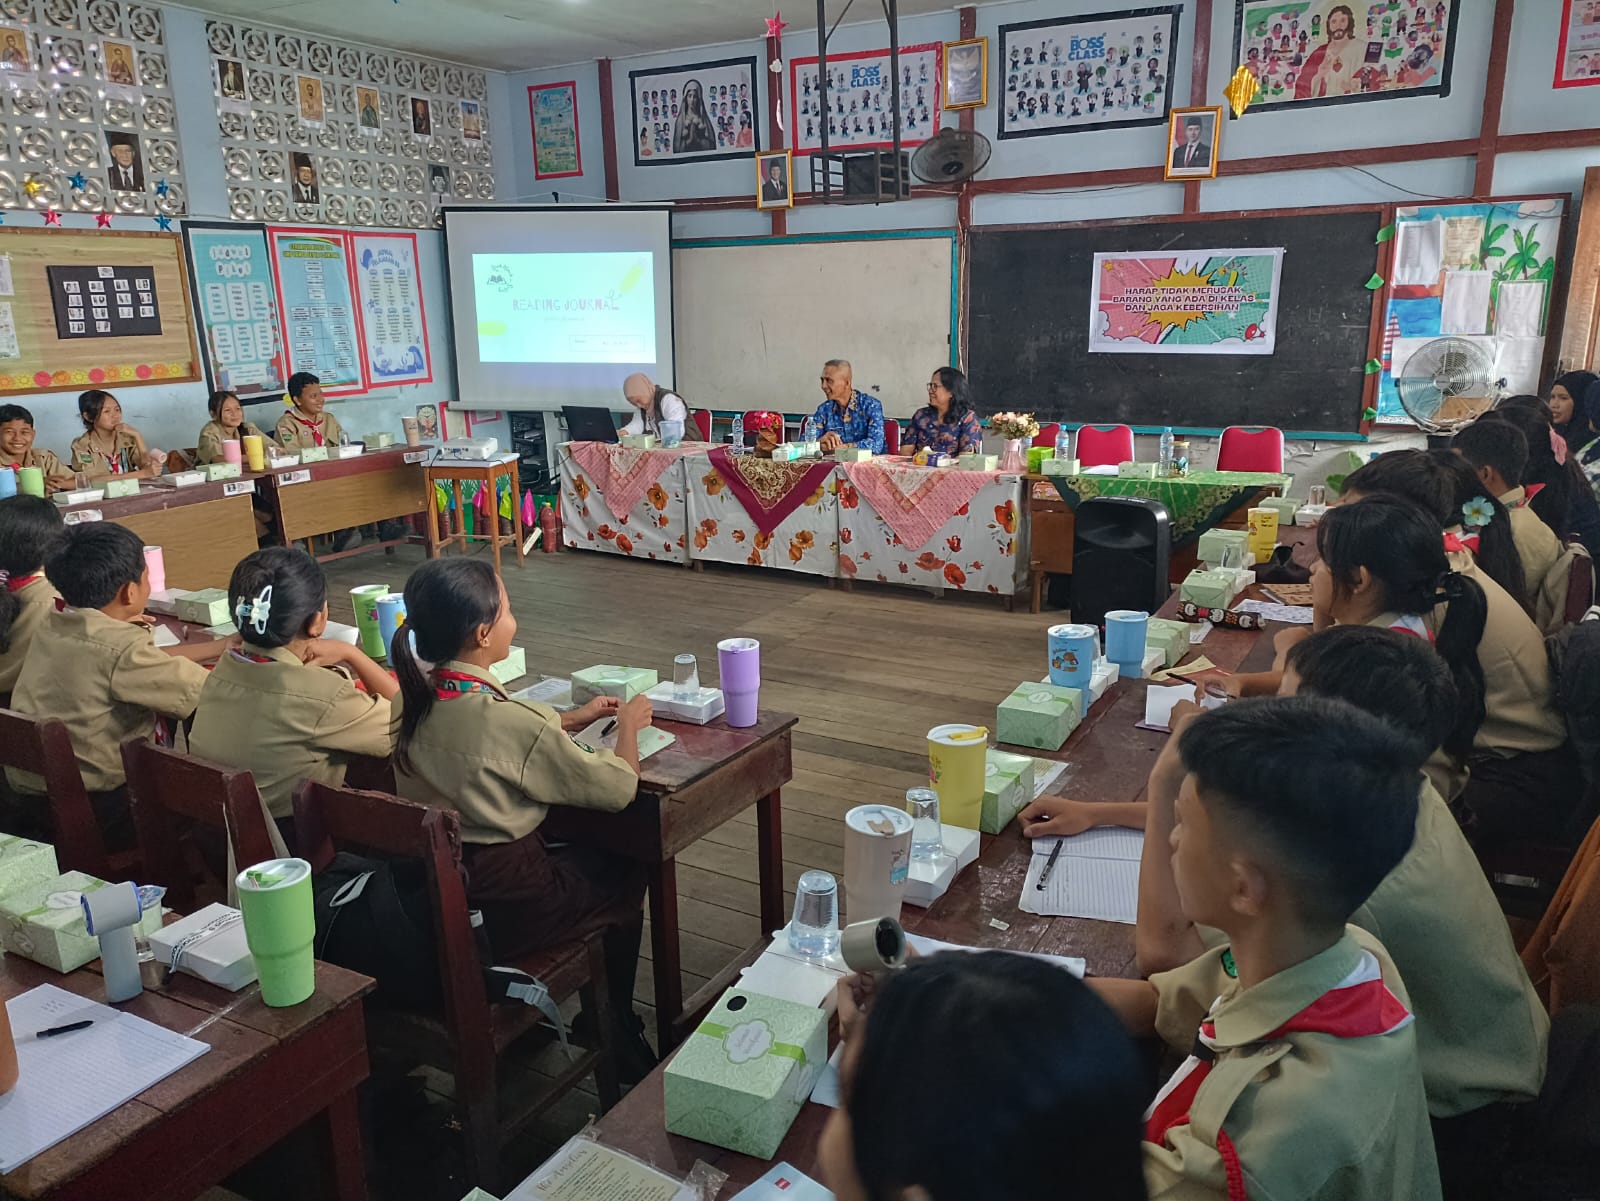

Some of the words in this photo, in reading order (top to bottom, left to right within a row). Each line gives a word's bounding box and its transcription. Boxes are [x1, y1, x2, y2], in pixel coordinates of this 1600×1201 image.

[1070, 36, 1104, 51] BOSS
[1068, 48, 1105, 61] CLASS
[852, 65, 879, 79] BOSS
[850, 77, 881, 88] CLASS
[513, 298, 561, 311] READING
[564, 297, 620, 311] JOURNAL
[1176, 303, 1239, 311] KEBERSIHAN
